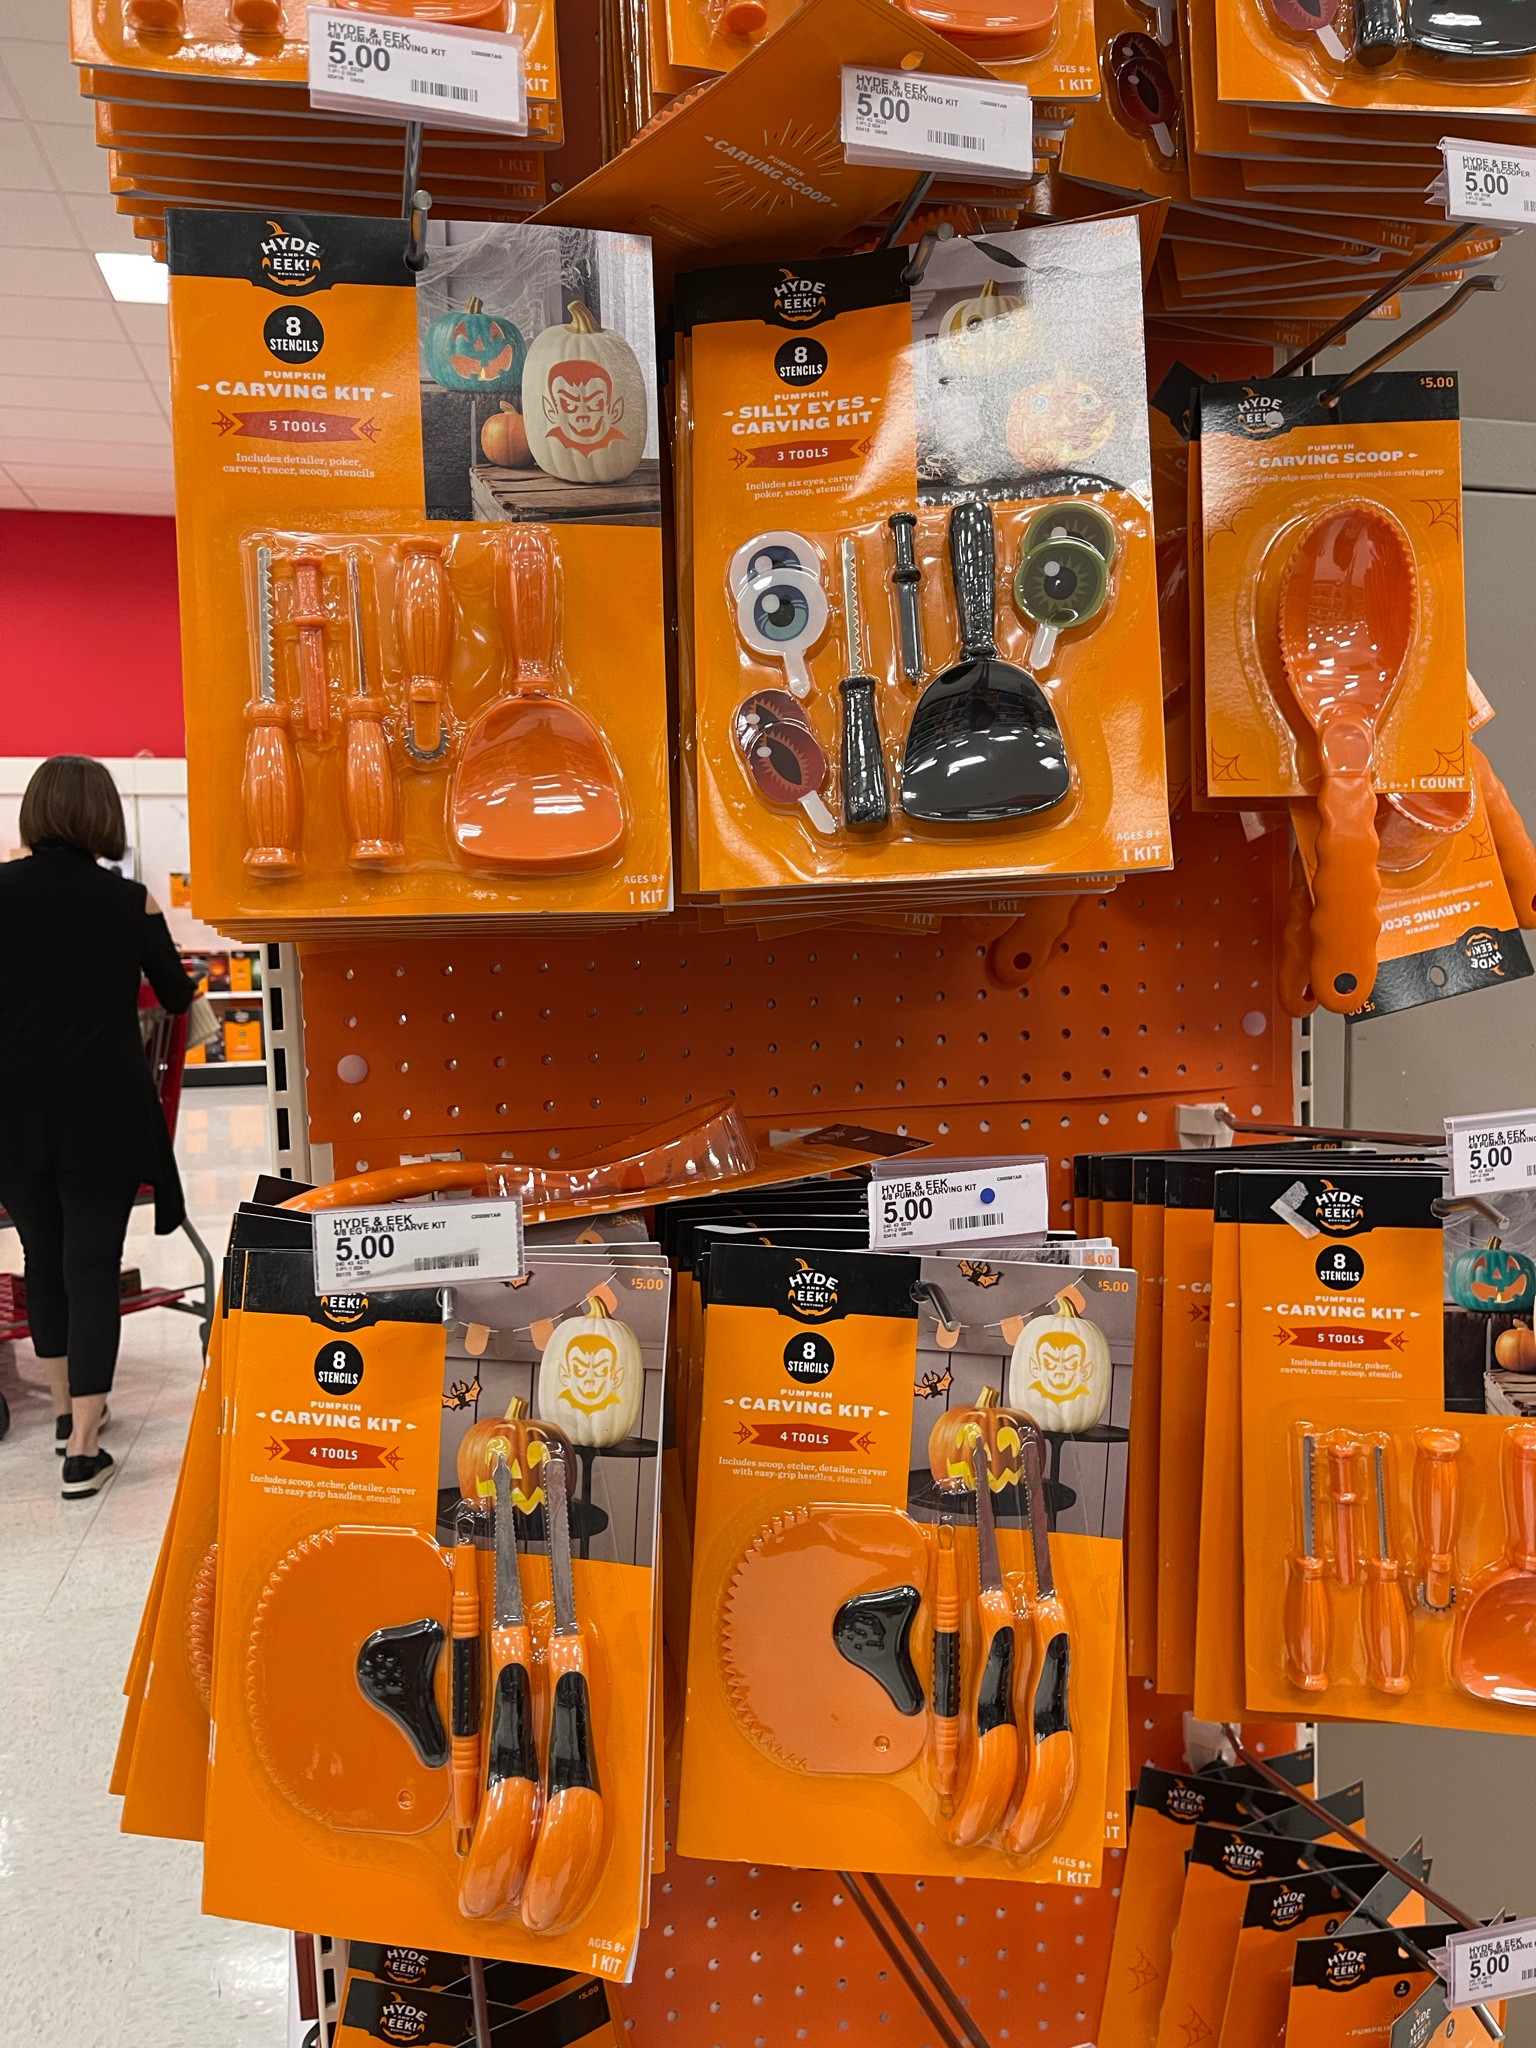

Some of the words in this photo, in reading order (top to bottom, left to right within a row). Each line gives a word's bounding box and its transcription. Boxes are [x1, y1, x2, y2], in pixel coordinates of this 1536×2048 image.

[328, 21, 365, 38] HYDE
[384, 30, 410, 44] EEK
[384, 40, 428, 54] CARVING
[431, 48, 446, 56] KIT
[329, 41, 390, 71] 5.00
[1053, 65, 1075, 73] AGES
[857, 75, 889, 88] HYDE
[905, 83, 928, 95] EEK
[1070, 79, 1093, 90] KIT
[870, 86, 902, 97] PUMKIN
[905, 92, 943, 104] CARVING
[946, 99, 958, 107] KIT
[857, 93, 910, 122] 5.00
[1463, 156, 1488, 166] HYDE
[1501, 161, 1520, 170] EEK
[714, 140, 783, 180] CARVING
[781, 175, 832, 204] SCOOP
[1496, 168, 1530, 177] SCOOPER
[1465, 172, 1508, 195] 5.00
[1390, 233, 1411, 246] KIT
[1474, 239, 1495, 252] KIT
[261, 237, 320, 257] HYDE
[273, 259, 310, 271] EEK!
[774, 280, 825, 297] HYDE
[784, 298, 817, 309] EEK!
[286, 317, 301, 336] 8
[269, 339, 319, 352] STENCILS
[794, 346, 808, 363] 8
[264, 371, 326, 380] PUMPKIN
[780, 364, 823, 377] STENCILS
[1420, 378, 1454, 388] $5.00
[216, 381, 327, 399] CARVING
[335, 387, 375, 401] KIT
[774, 391, 829, 401] PUMPKIN
[739, 403, 806, 419] SILLY
[808, 396, 864, 415] EYES
[1238, 397, 1282, 412] HYDE
[269, 420, 277, 430] 5
[282, 420, 327, 432] TOOLS
[732, 417, 830, 435] CARVING
[837, 411, 872, 427] KIT
[236, 453, 281, 464] Includes
[284, 455, 327, 466] detailer,
[329, 458, 361, 468] poker,
[778, 452, 784, 461] 3
[789, 448, 829, 460] TOOLS
[1259, 453, 1339, 468] CARVING
[1343, 451, 1403, 464] SCOOP
[223, 465, 260, 474] carver,
[262, 466, 298, 476] tracer,
[299, 467, 332, 478] scoop,
[334, 468, 375, 478] stencils
[746, 481, 786, 491] Includes
[788, 480, 801, 488] six
[803, 478, 827, 487] eyes,
[754, 490, 783, 500] poker,
[785, 487, 814, 496] scoop,
[1420, 778, 1464, 788] COUNT
[1116, 832, 1143, 842] AGES
[1134, 846, 1162, 861] KIT
[624, 875, 648, 884] AGES
[641, 890, 664, 904] KIT
[1414, 901, 1471, 923] CARVING
[1405, 923, 1439, 935] PUMPKIN
[1472, 943, 1492, 956] EEK!
[1471, 951, 1503, 969] HYDE
[1469, 1133, 1494, 1143] HYDE
[1507, 1129, 1526, 1140] EEK
[1470, 1146, 1512, 1169] 5.00
[882, 1183, 911, 1194] HYDE
[926, 1179, 947, 1188] EEK
[895, 1190, 925, 1199] PUMKIN
[927, 1186, 962, 1195] CARVING
[1315, 1192, 1364, 1207] HYDE
[884, 1197, 932, 1223] 5.00
[1325, 1208, 1354, 1219] EEK!
[334, 1218, 369, 1229] HYDE
[387, 1214, 412, 1225] EEK
[366, 1225, 395, 1233] PMKIN
[398, 1222, 429, 1231] CARVE
[432, 1221, 446, 1229] KIT
[336, 1234, 394, 1261] 5.00
[1333, 1253, 1346, 1269] 8
[789, 1273, 839, 1290] HYDE
[1321, 1271, 1359, 1281] STENCILS
[632, 1279, 664, 1290] $5.00
[1098, 1281, 1129, 1292] $5.00
[330, 1297, 360, 1309] EEK!
[798, 1291, 829, 1303] EEK!
[1315, 1295, 1365, 1303] PUMPKIN
[1277, 1304, 1366, 1318] CARVING
[1371, 1308, 1405, 1320] KIT
[1318, 1334, 1324, 1342] 5
[1328, 1334, 1364, 1344] TOOLS
[803, 1342, 815, 1359] 8
[333, 1351, 346, 1369] 8
[1291, 1358, 1326, 1367] Includes
[1328, 1360, 1363, 1369] detailer,
[788, 1361, 829, 1374] STENCILS
[318, 1371, 358, 1385] STENCILS
[781, 1389, 833, 1398] PUMPKIN
[310, 1401, 361, 1411] PUMPKIN
[739, 1397, 832, 1415] CARVING
[838, 1405, 873, 1418] KIT
[271, 1410, 361, 1429] CARVING
[367, 1417, 402, 1432] KIT
[780, 1432, 787, 1441] 4
[792, 1433, 829, 1444] TOOLS
[310, 1447, 317, 1456] 4
[321, 1448, 358, 1460] TOOLS
[718, 1457, 756, 1467] Includes
[758, 1461, 785, 1470] scoop,
[787, 1463, 818, 1472] etcher,
[819, 1464, 856, 1475] detailer,
[858, 1468, 887, 1476] carver
[733, 1468, 753, 1476] with
[754, 1470, 796, 1480] easy-grip
[837, 1476, 872, 1484] stencils
[250, 1474, 286, 1485] Includes
[288, 1478, 315, 1487] scoop,
[317, 1481, 347, 1490] etcher,
[349, 1482, 385, 1493] detailer,
[387, 1487, 416, 1495] carver
[264, 1486, 284, 1494] with
[285, 1488, 326, 1499] easy-grip
[366, 1495, 401, 1504] stencils
[1168, 1788, 1205, 1804] HYDE
[1172, 1800, 1198, 1811] EEK!
[1224, 1844, 1264, 1860] HYDE
[1052, 1856, 1076, 1867] AGES
[1079, 1861, 1092, 1869] 8+
[1229, 1856, 1255, 1868] EEK!
[1067, 1871, 1091, 1884] KIT
[1273, 1892, 1305, 1908] HYDE
[1276, 1905, 1298, 1917] EEK!
[588, 1938, 612, 1950] AGES
[1469, 1943, 1493, 1955] HYDE
[1505, 1937, 1521, 1947] EEK
[386, 1949, 429, 1966] HYDE
[600, 1955, 622, 1974] KIT
[1327, 1950, 1366, 1966] HYDE
[392, 1961, 420, 1974] EEK!
[1333, 1964, 1358, 1976] EEK!
[1470, 1954, 1509, 1978] 5.00
[382, 2004, 428, 2021] HYDE
[388, 2018, 416, 2031] EEK!
